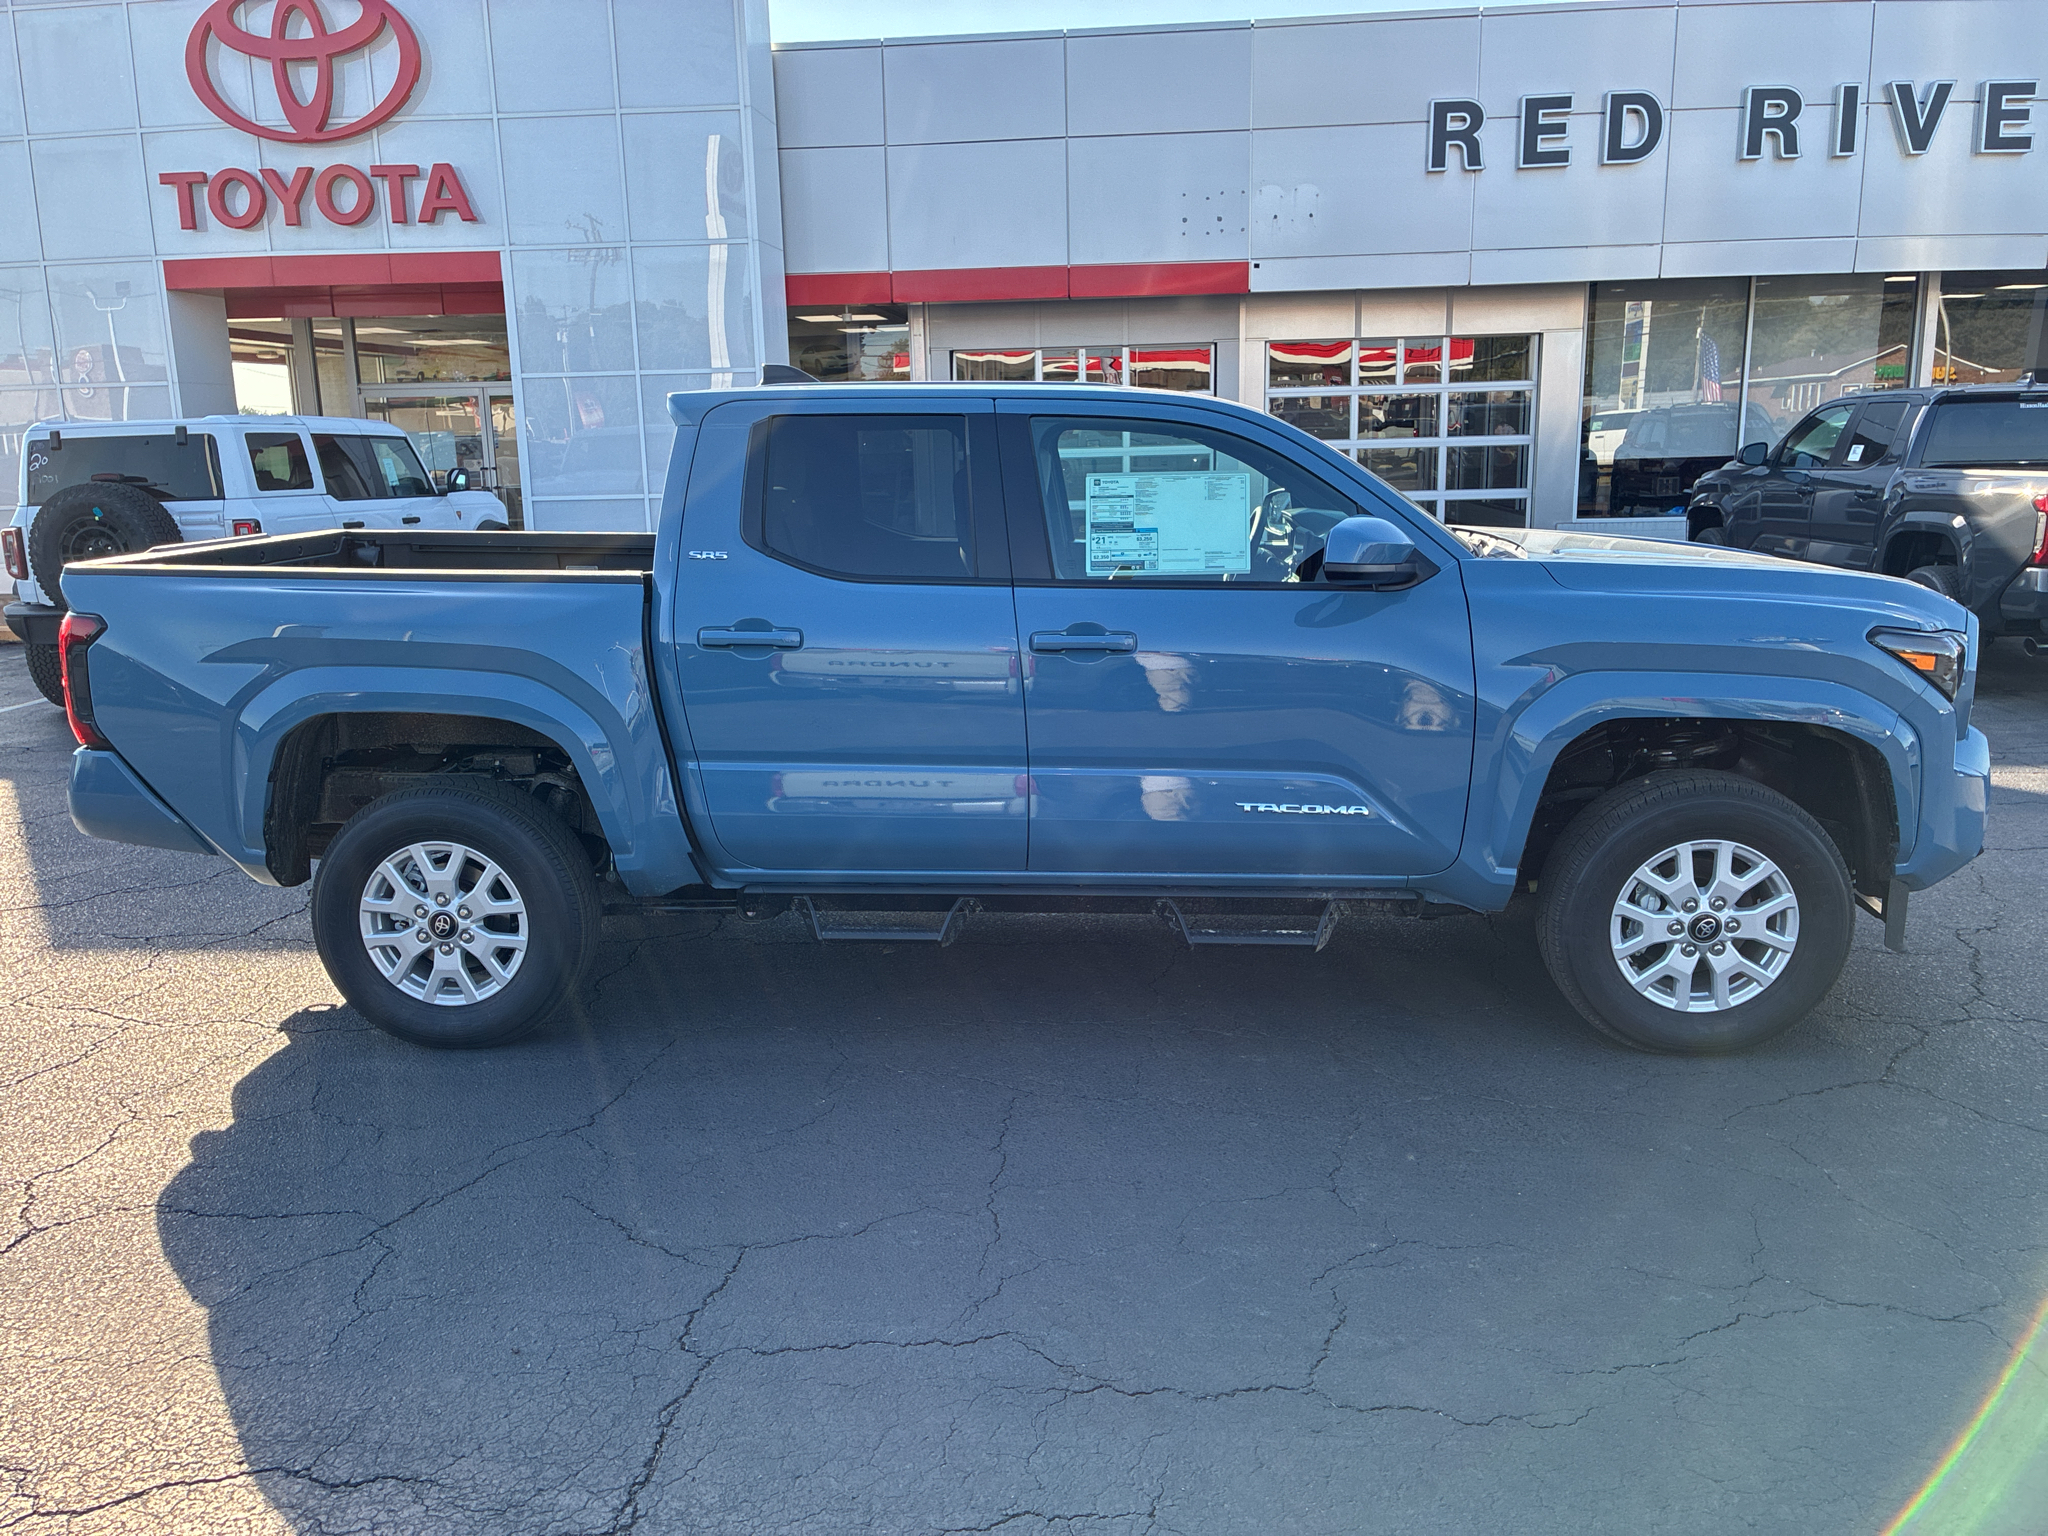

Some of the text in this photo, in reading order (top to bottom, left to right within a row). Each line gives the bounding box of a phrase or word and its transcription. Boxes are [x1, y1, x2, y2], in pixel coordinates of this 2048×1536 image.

[1426, 79, 2040, 172] RED RIVE
[158, 162, 478, 231] TOYOTA
[30, 453, 48, 471] 20
[1095, 536, 1106, 544] 21
[688, 550, 728, 560] SR5
[1235, 802, 1370, 816] TACOMA
